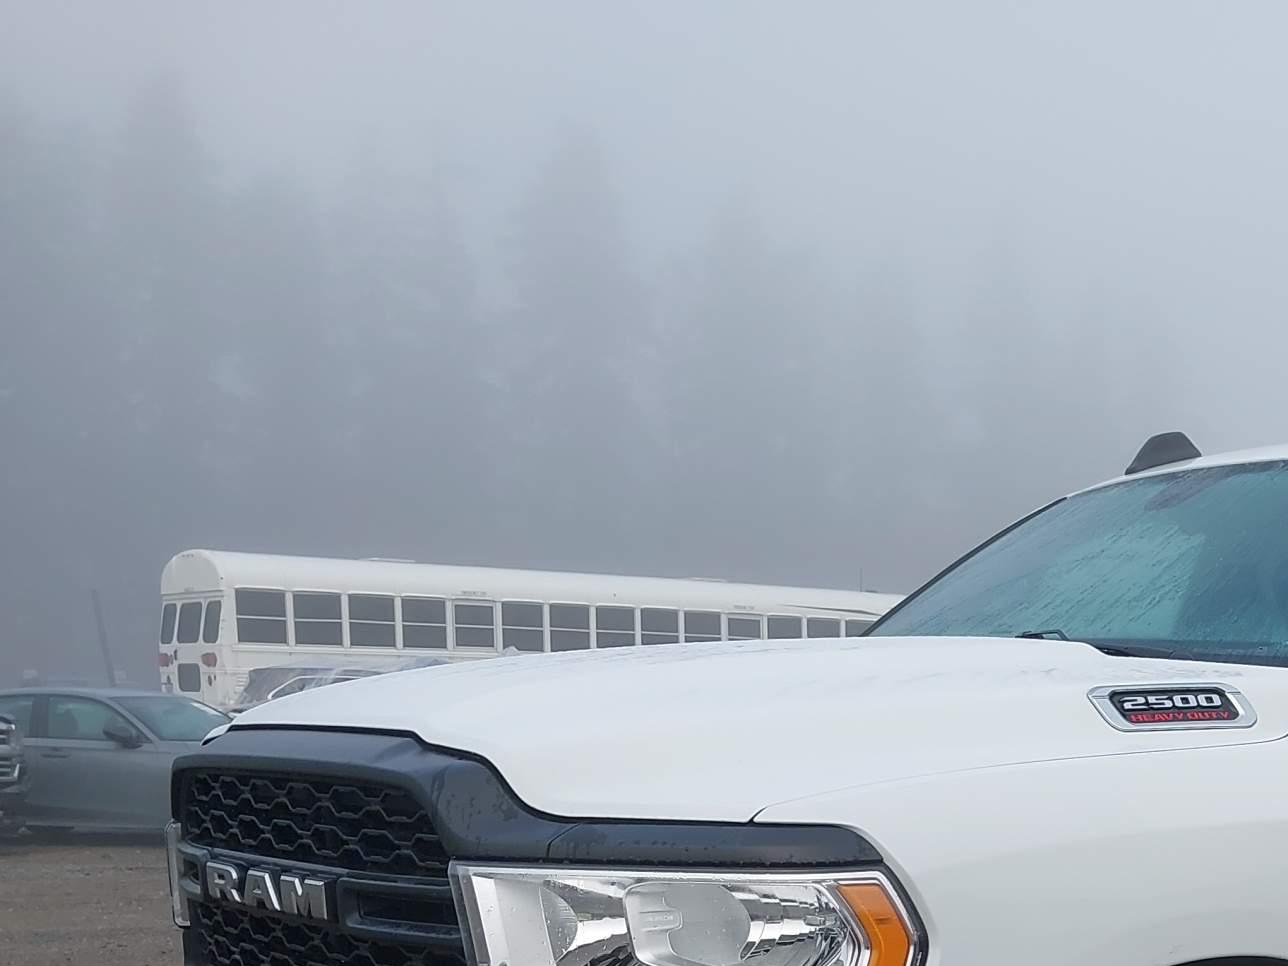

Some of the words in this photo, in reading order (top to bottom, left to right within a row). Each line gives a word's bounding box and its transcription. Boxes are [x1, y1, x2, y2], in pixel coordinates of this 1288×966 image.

[1120, 693, 1223, 710] 2500
[1130, 712, 1185, 722] HEAVY
[1186, 711, 1230, 721] DUTY
[205, 860, 328, 921] RAM
